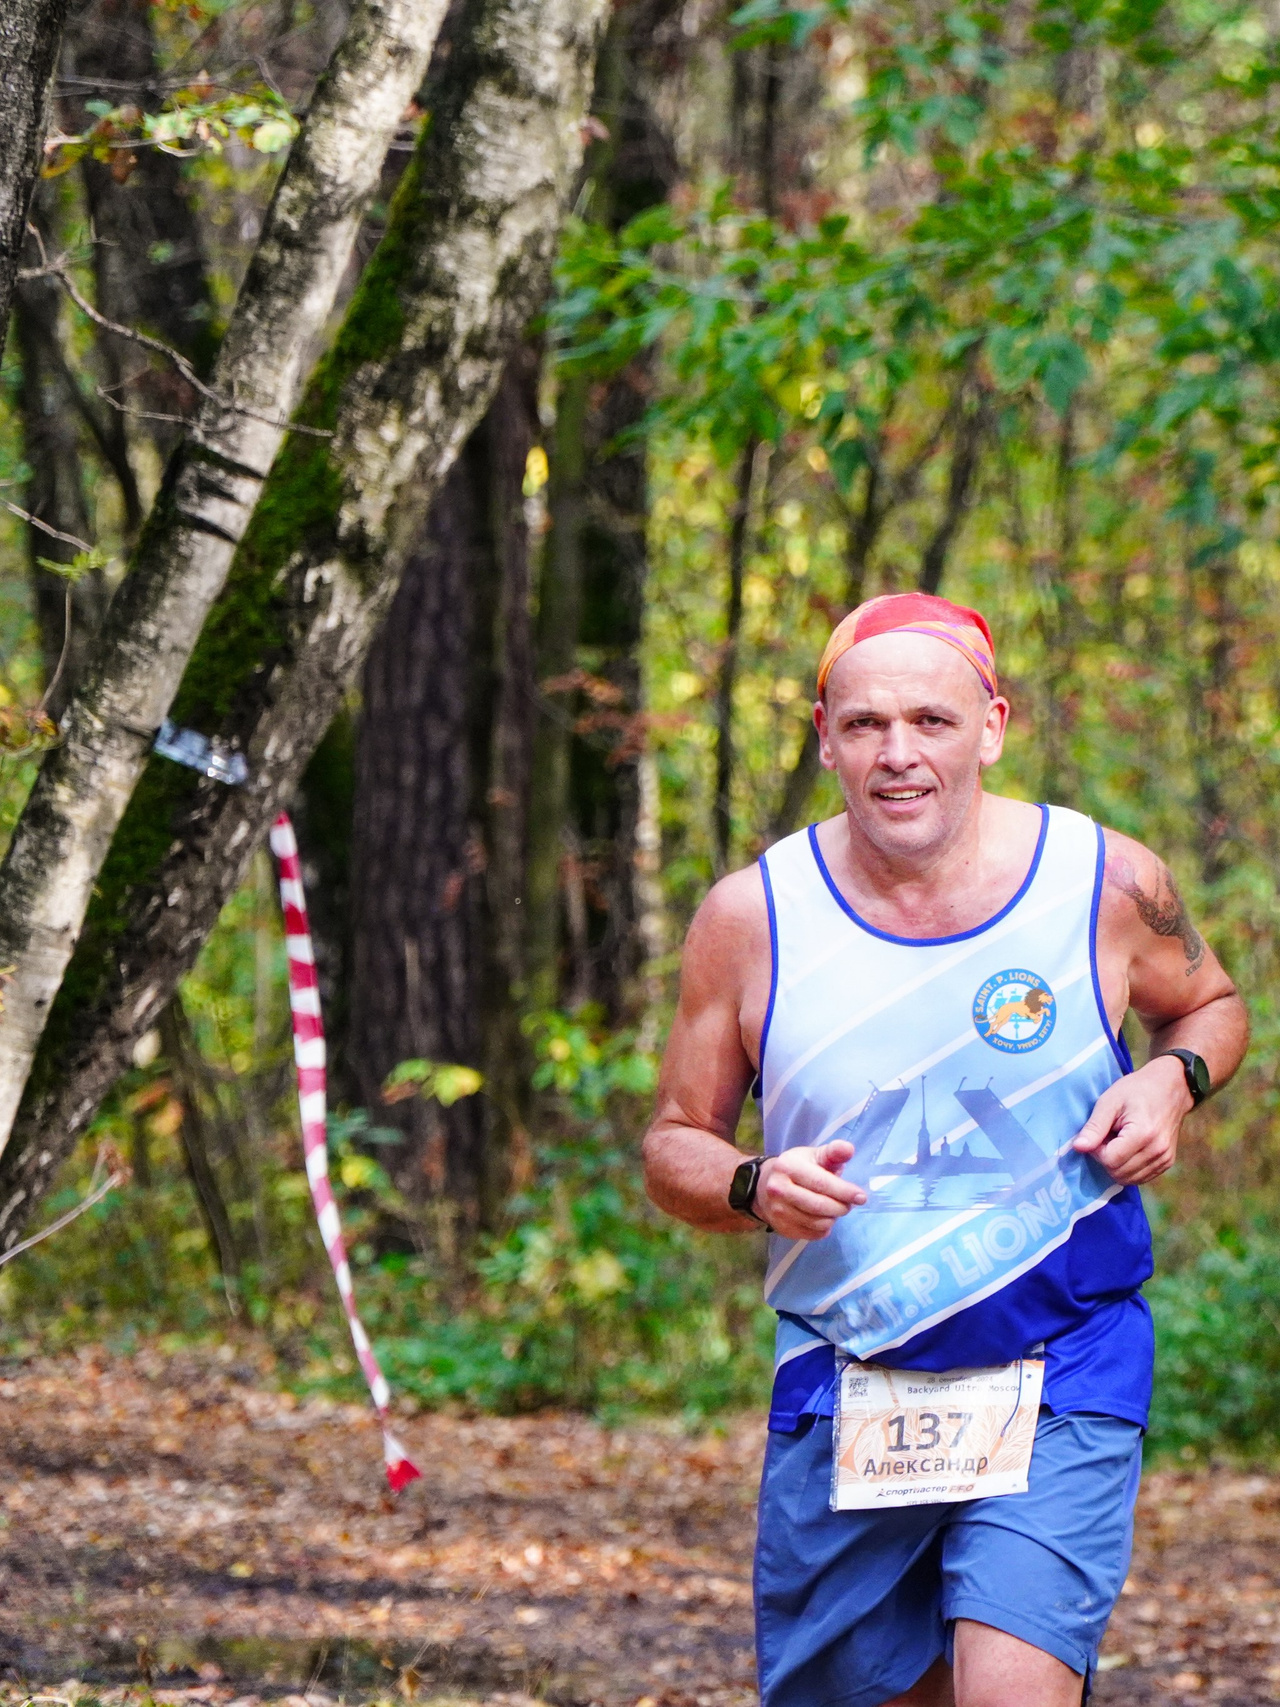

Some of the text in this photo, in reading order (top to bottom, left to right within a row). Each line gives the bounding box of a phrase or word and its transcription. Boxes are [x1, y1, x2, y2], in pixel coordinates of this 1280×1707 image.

[1009, 972, 1041, 987] LIONS
[941, 1172, 1073, 1288] LIONS
[907, 1384, 950, 1394] Backyard
[886, 1412, 974, 1453] 137
[863, 1456, 989, 1477] Александр
